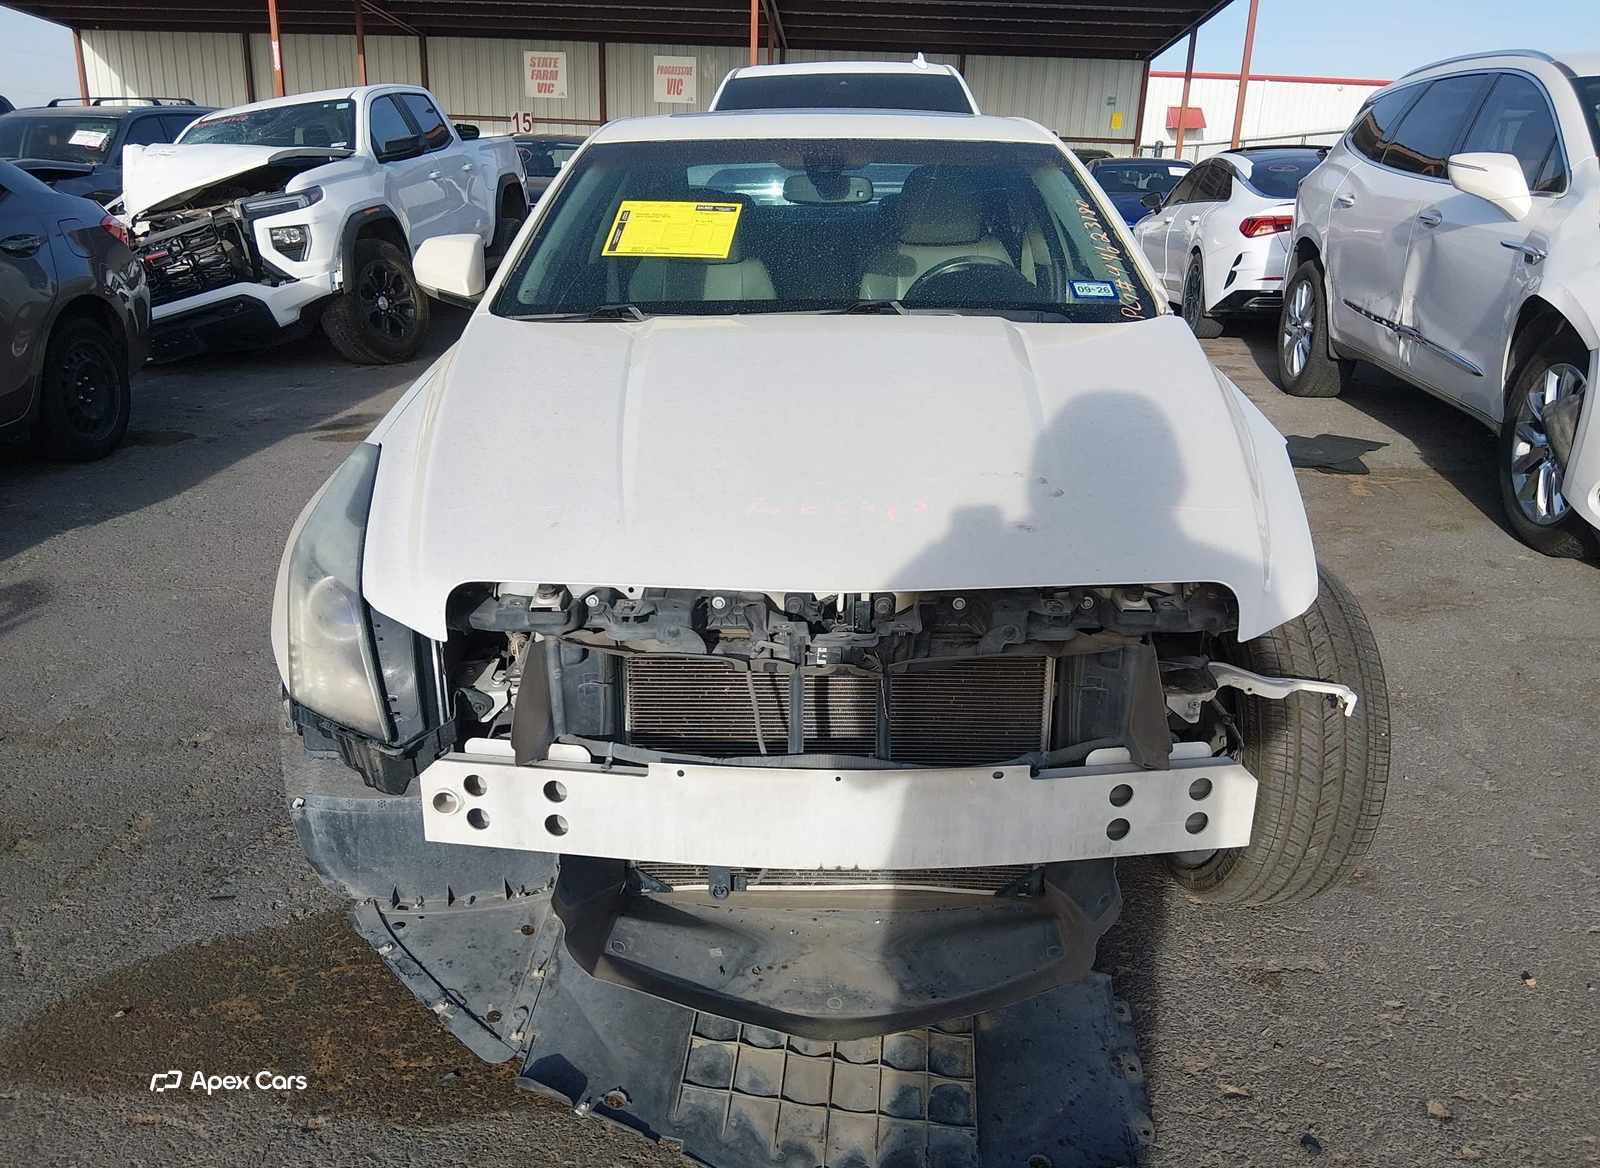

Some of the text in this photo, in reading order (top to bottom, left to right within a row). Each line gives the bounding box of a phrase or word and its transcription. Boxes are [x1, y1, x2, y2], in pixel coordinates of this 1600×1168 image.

[529, 56, 559, 68] STATE
[530, 69, 559, 81] FARM
[656, 65, 694, 76] PROGRESSIVE
[537, 82, 555, 94] VIC
[666, 78, 684, 95] VIC
[512, 112, 532, 133] 15
